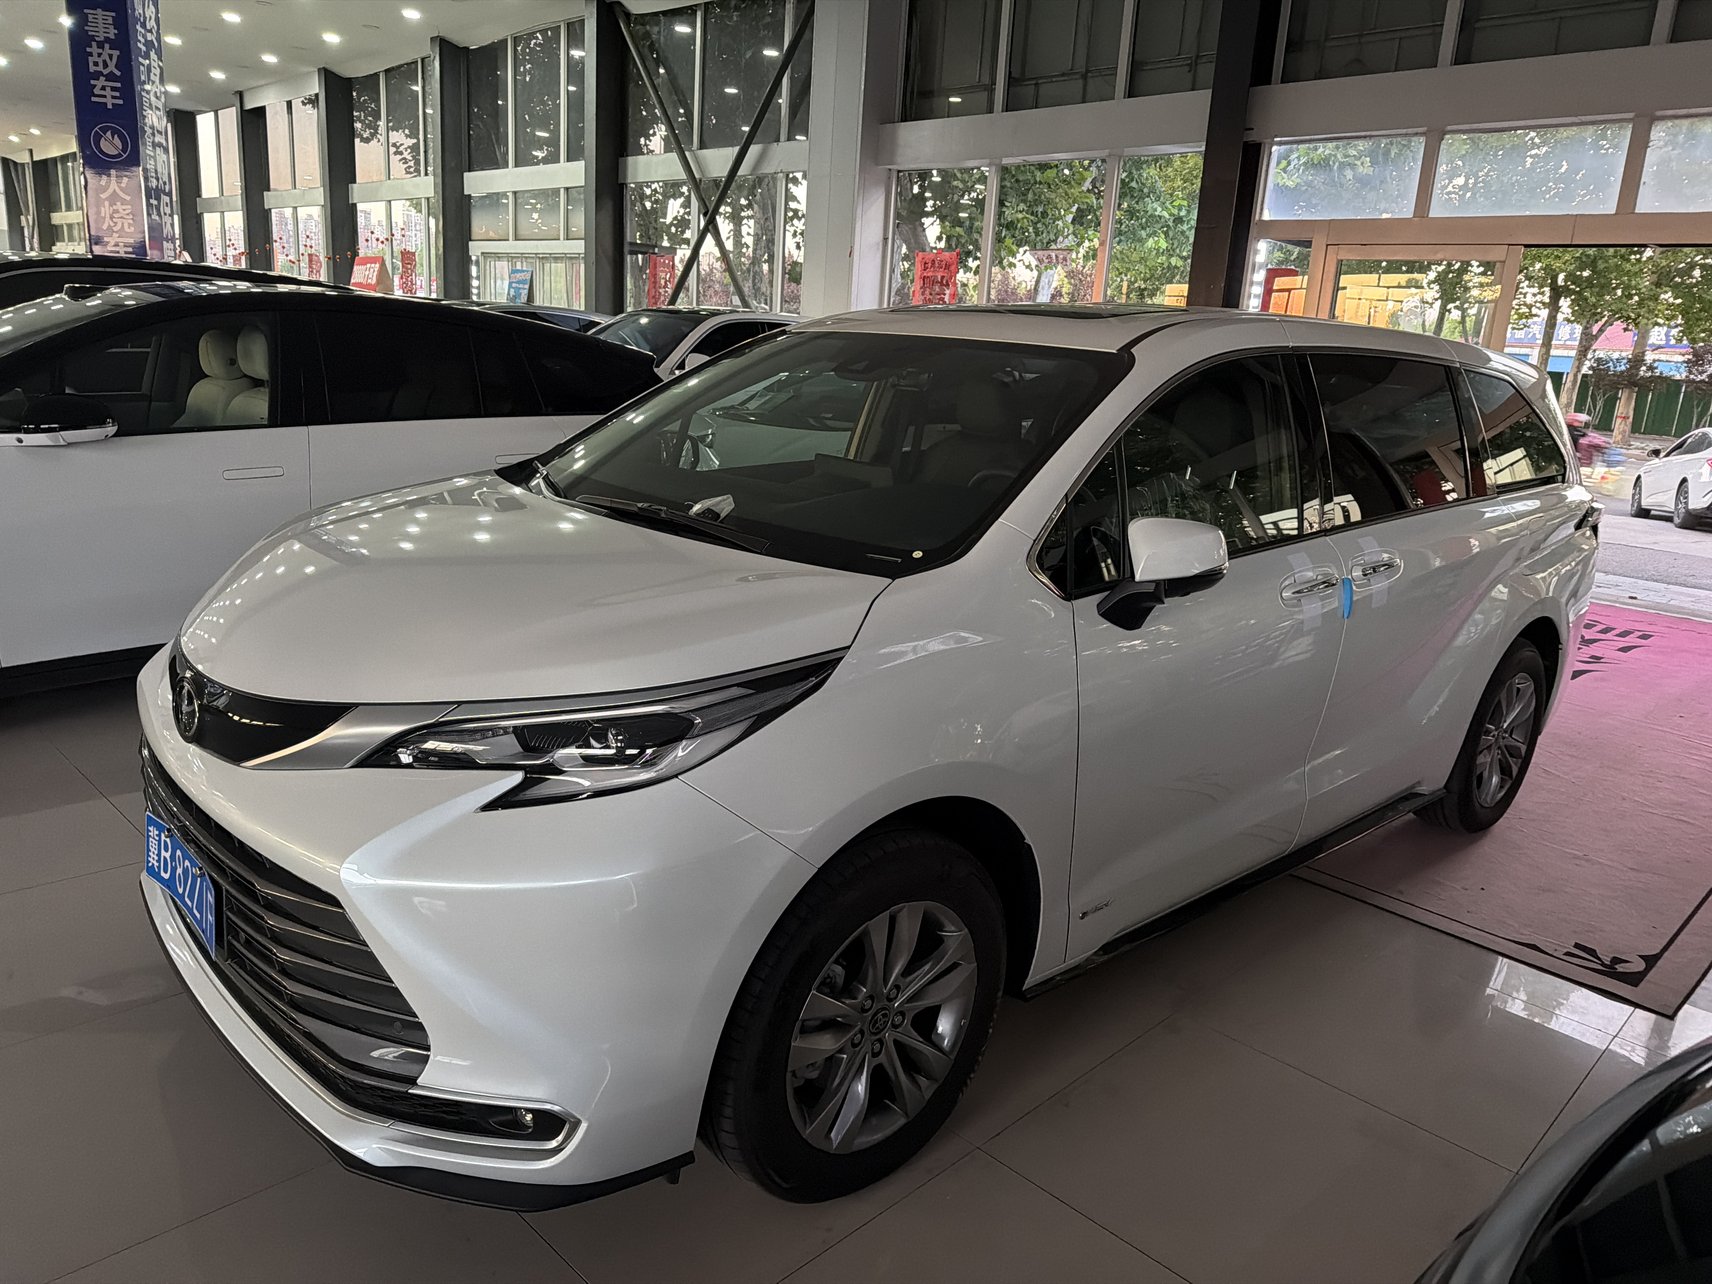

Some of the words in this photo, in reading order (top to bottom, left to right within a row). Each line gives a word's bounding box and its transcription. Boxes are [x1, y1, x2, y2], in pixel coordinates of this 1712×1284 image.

[83, 8, 124, 109] 事故车
[100, 169, 135, 256] 火烧车
